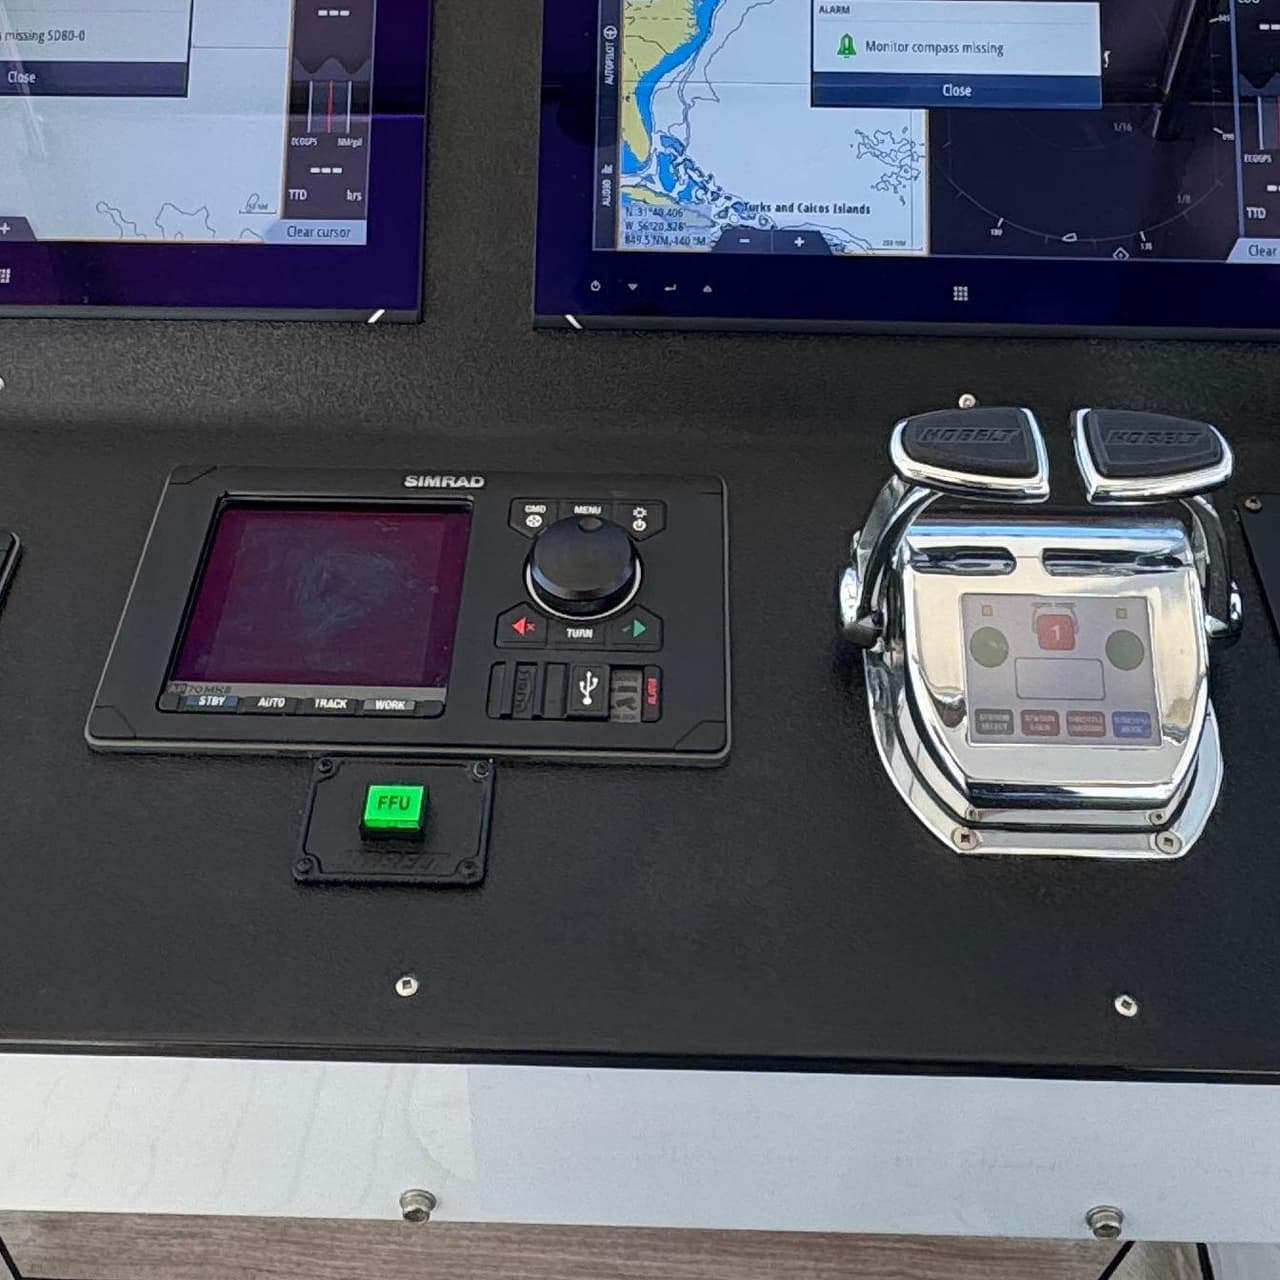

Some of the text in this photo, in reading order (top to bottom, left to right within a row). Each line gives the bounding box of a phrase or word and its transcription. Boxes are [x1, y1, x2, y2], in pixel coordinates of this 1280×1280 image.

[819, 5, 851, 15] ALARM
[5, 29, 45, 44] missing
[865, 40, 1004, 57] Monitor compass missing
[605, 42, 615, 85] AUTOPILOT
[7, 70, 37, 84] Close
[942, 83, 972, 97] Close
[288, 189, 362, 201] TTD hrs
[744, 202, 871, 215] Turks and Caicos Islands
[1246, 206, 1266, 219] TTD
[286, 225, 351, 238] Clear cursor
[1248, 244, 1277, 257] Clear
[921, 428, 1020, 443] KOBELT
[1105, 430, 1202, 444] KOBELT
[404, 475, 485, 488] SIMRAD
[574, 505, 601, 514] MENU
[566, 627, 593, 638] TURN
[1051, 624, 1061, 641] 1
[198, 695, 226, 706] STBY
[257, 697, 286, 707] AUTO
[314, 698, 348, 709] TRACK
[375, 700, 406, 710] WORK
[377, 795, 411, 811] FFU
